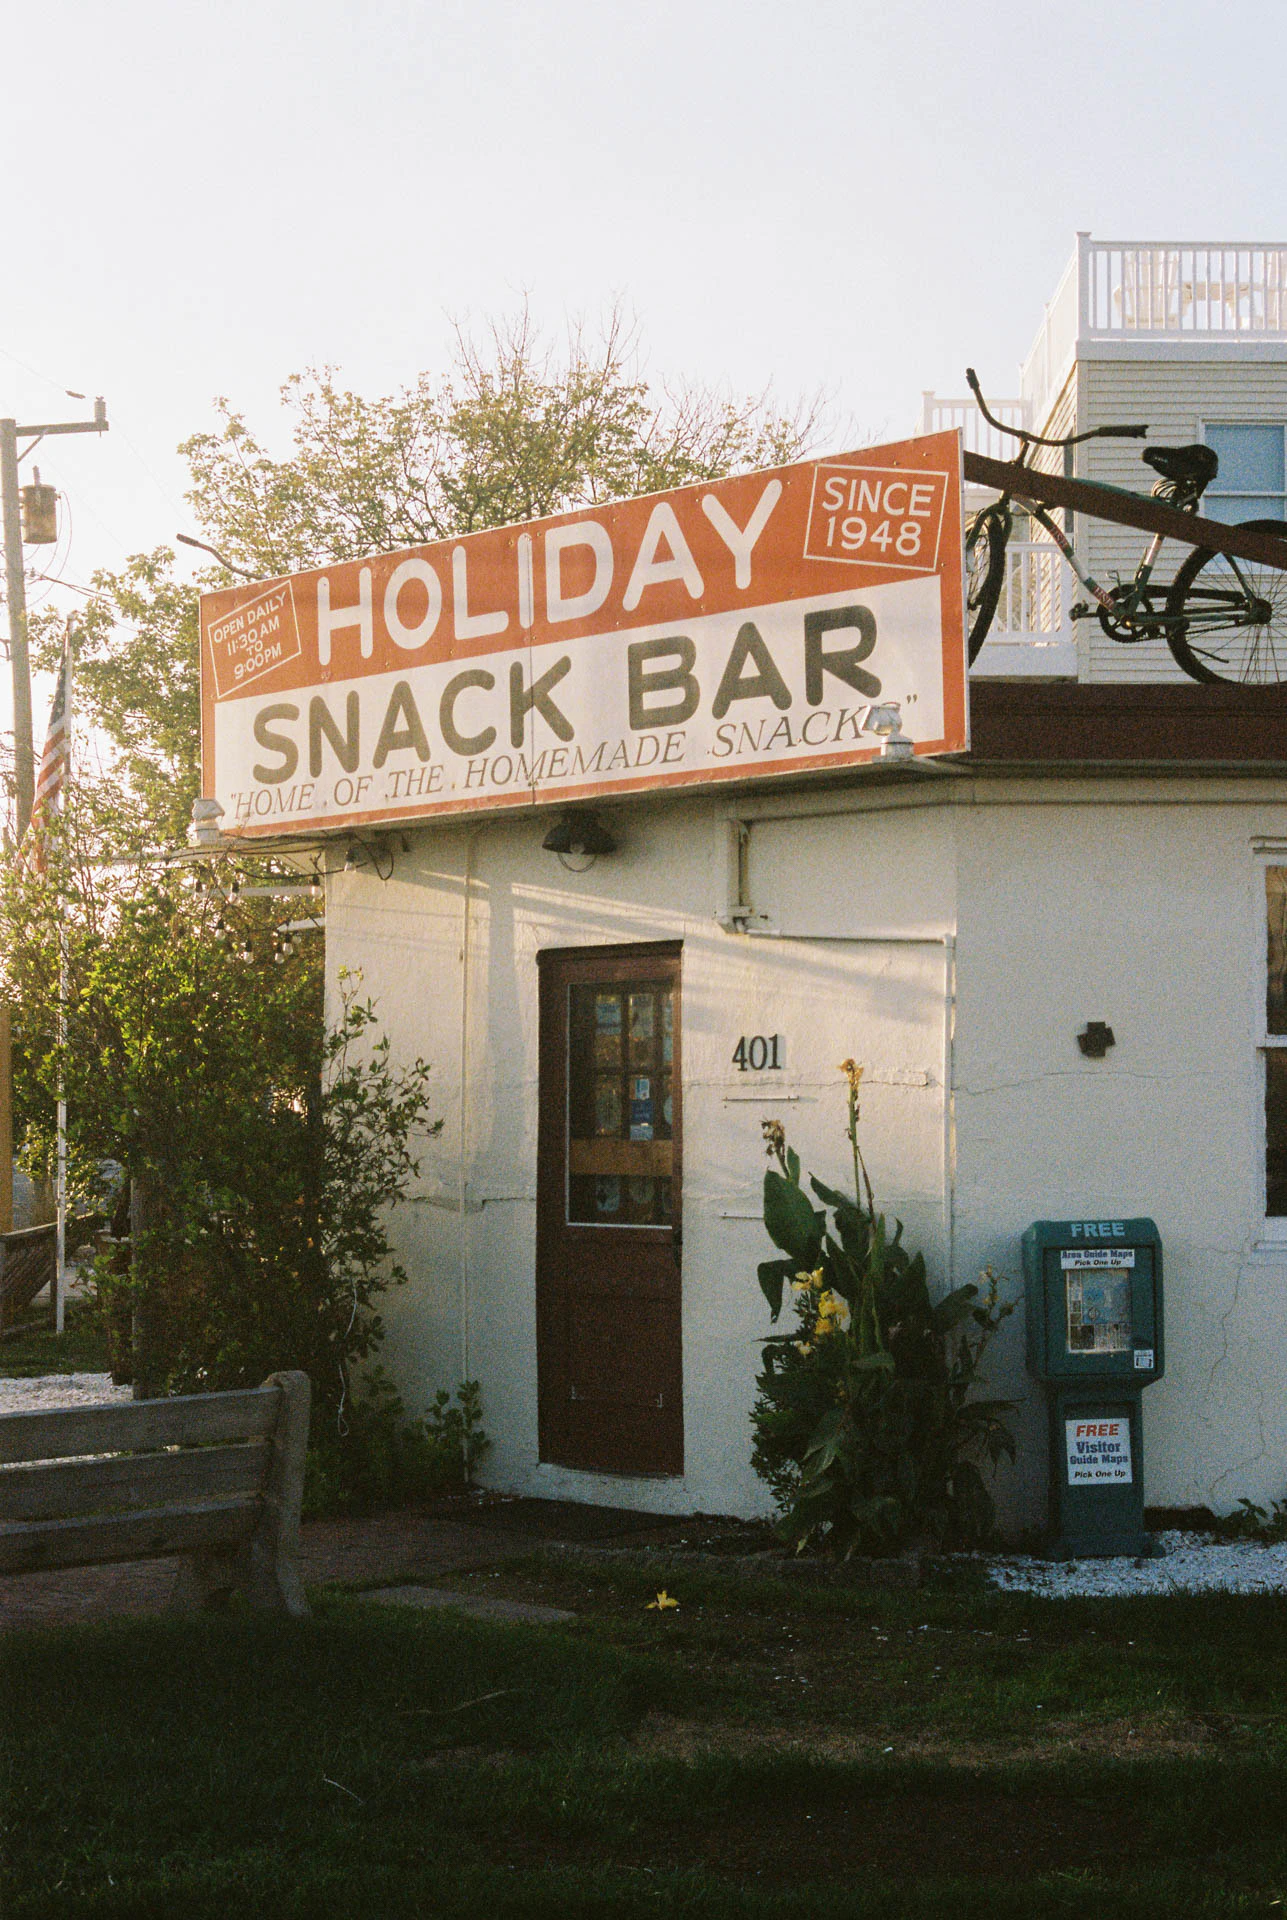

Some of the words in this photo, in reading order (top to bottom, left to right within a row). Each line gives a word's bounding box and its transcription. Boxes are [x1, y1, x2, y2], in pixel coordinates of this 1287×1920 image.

[822, 476, 935, 518] SINCE
[826, 516, 923, 556] 1948
[317, 478, 783, 666] HOLIDAY
[213, 616, 245, 643] OPEN
[247, 591, 286, 625] DAILY
[227, 629, 258, 656] 11:30
[260, 615, 280, 638] AM
[246, 640, 263, 656] TO
[252, 655, 575, 785] SNACK
[628, 605, 882, 731] BAR
[333, 775, 373, 807] OF
[388, 765, 444, 799] THE
[464, 731, 687, 789] HOMEMADE
[731, 1033, 782, 1072] 401
[1070, 1222, 1126, 1238] FREE
[1062, 1250, 1082, 1259] Area
[1084, 1249, 1108, 1258] Guide
[1111, 1249, 1133, 1259] Maps
[1076, 1423, 1120, 1437] FREE
[1076, 1441, 1121, 1453] Visitor
[1069, 1455, 1098, 1464] Guide
[1101, 1454, 1128, 1465] Maps
[1095, 1470, 1112, 1478] One
[1114, 1469, 1126, 1478] Up
